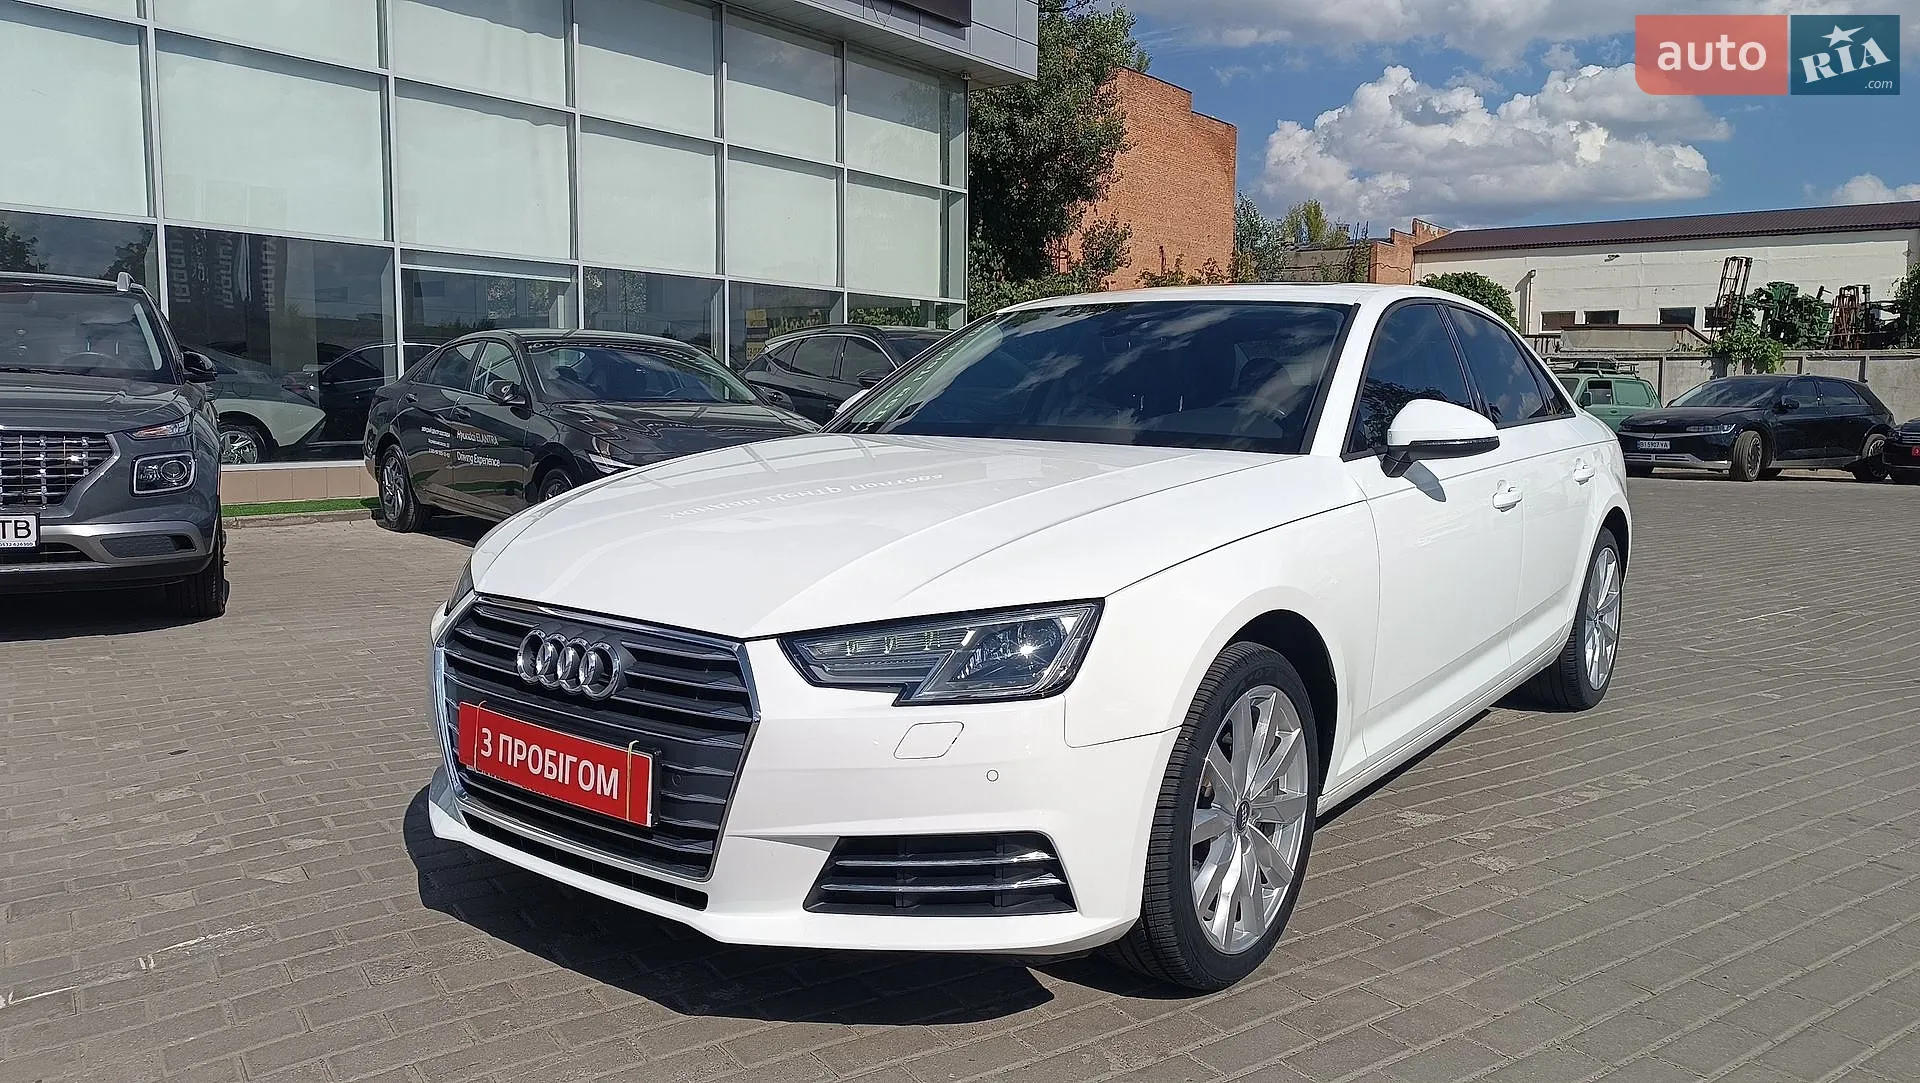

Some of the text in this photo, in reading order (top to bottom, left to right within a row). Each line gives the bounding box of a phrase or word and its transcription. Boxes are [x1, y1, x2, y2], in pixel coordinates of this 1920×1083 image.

[262, 239, 277, 312] YUNDAI
[456, 430, 476, 441] Hyundai
[476, 433, 499, 445] ELANTRA
[456, 451, 473, 464] Driving
[474, 454, 501, 467] Experience
[480, 727, 620, 800] З ПРОБІГОМ
